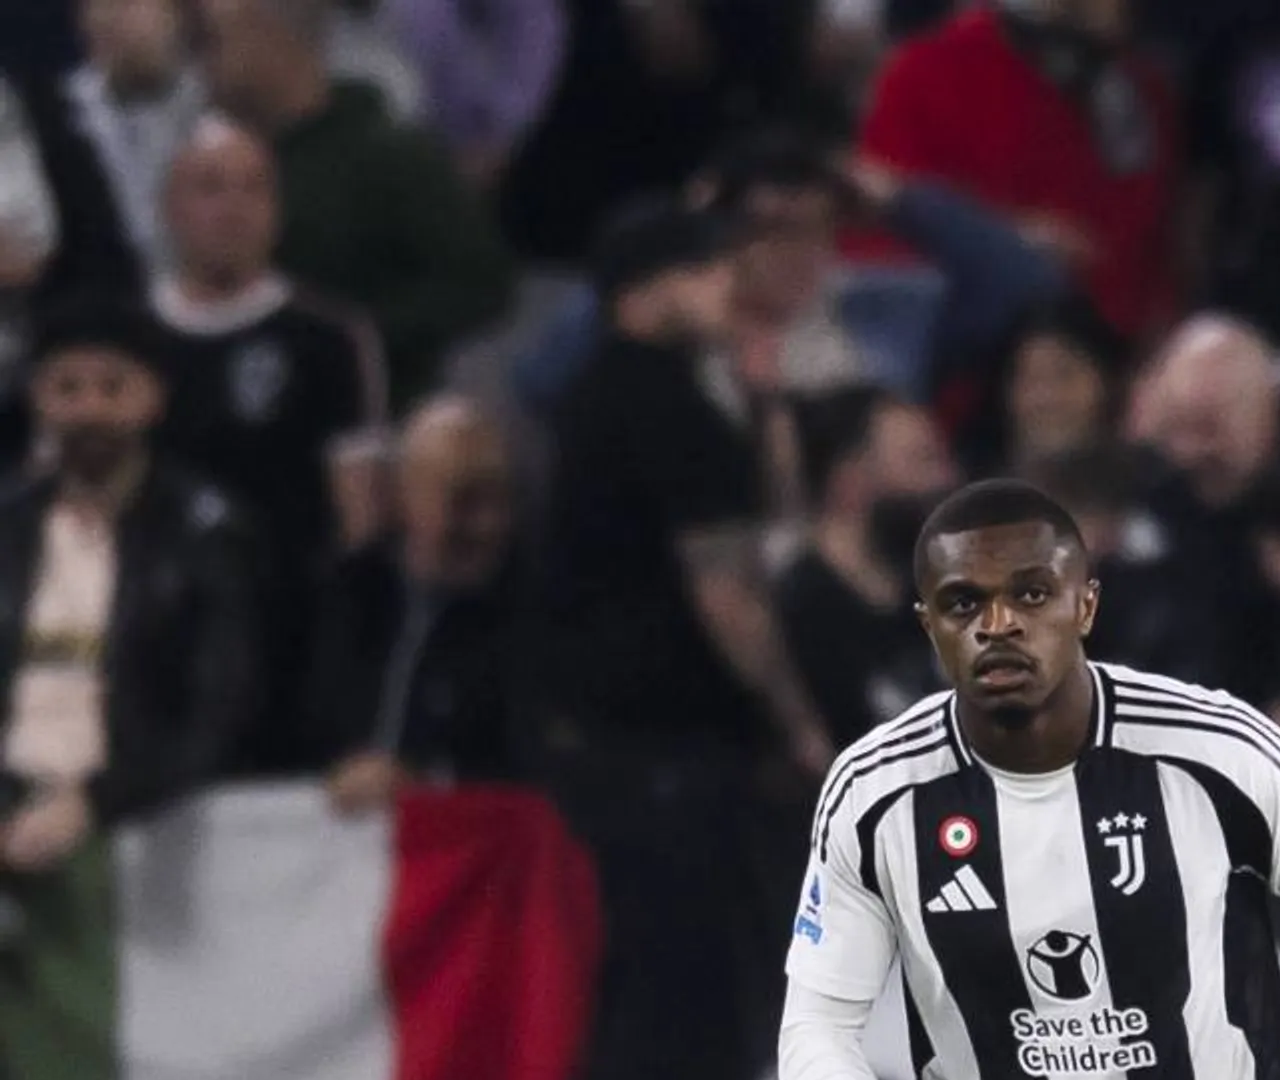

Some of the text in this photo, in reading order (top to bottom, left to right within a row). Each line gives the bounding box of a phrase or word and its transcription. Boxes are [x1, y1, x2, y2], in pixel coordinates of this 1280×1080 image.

[1013, 1007, 1144, 1038] Save the
[1021, 1043, 1152, 1073] Children
